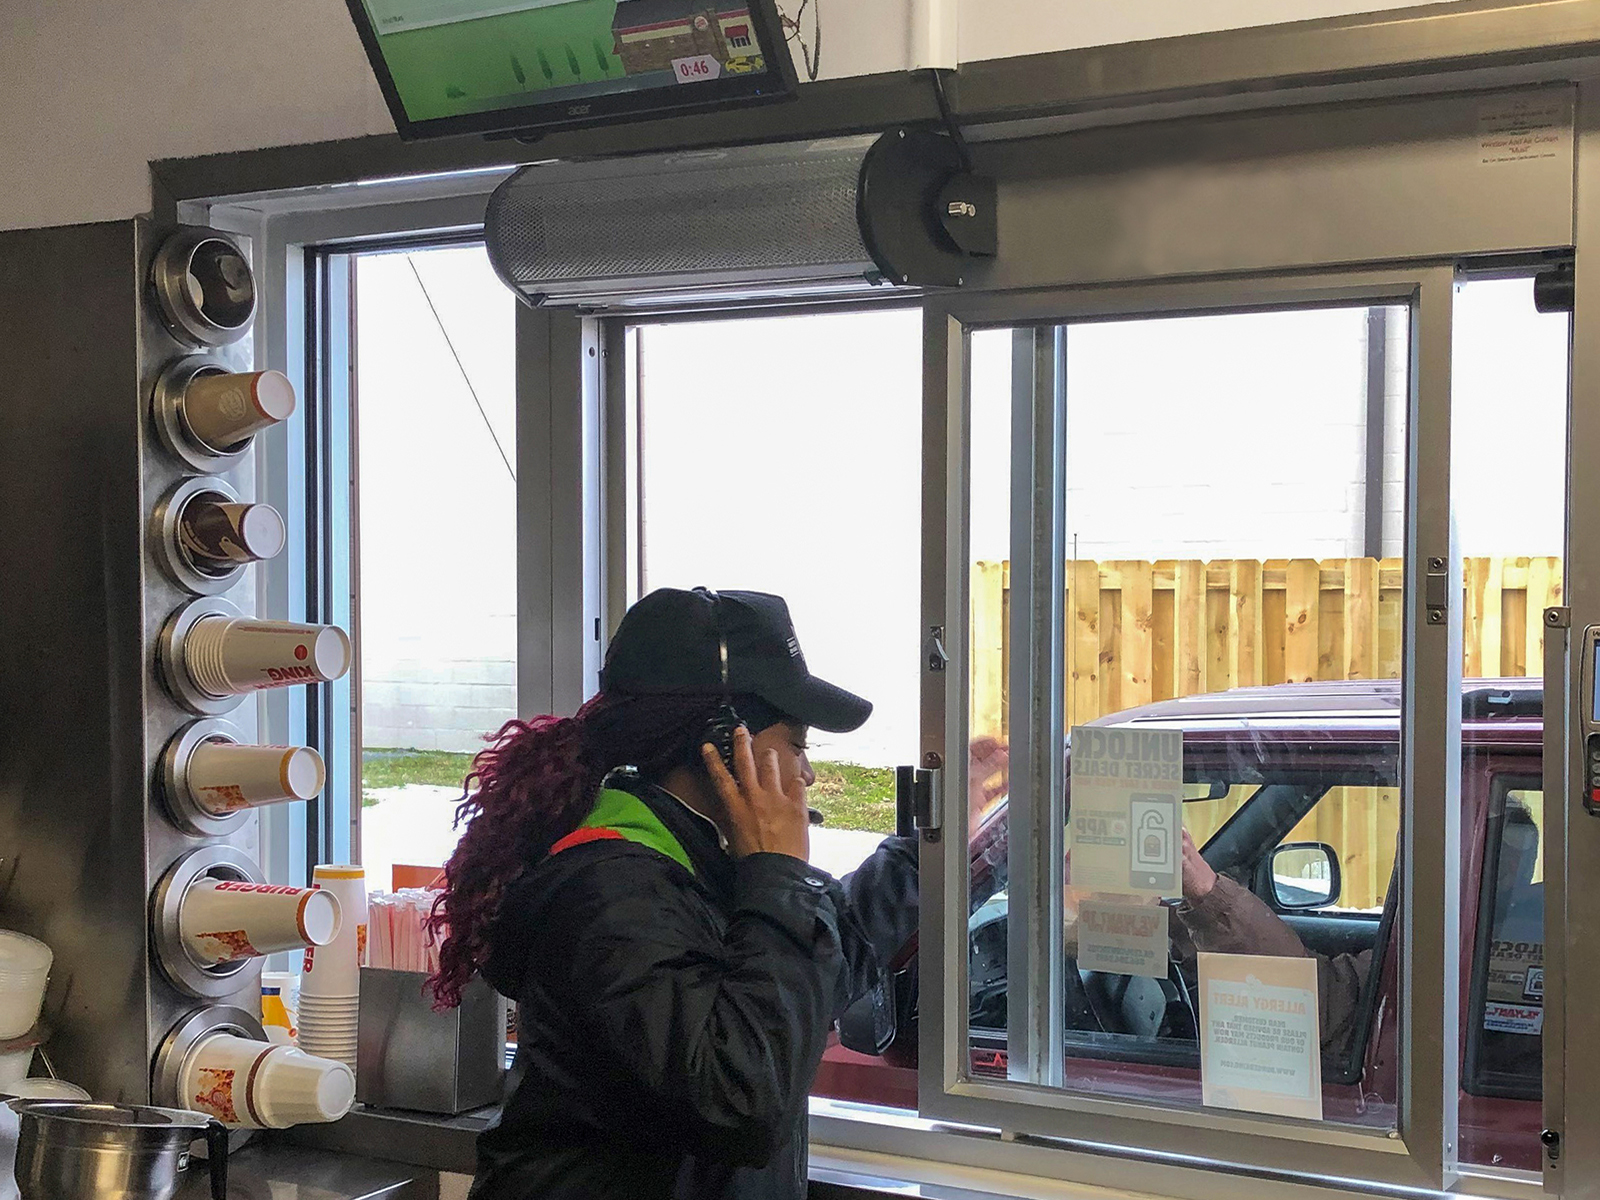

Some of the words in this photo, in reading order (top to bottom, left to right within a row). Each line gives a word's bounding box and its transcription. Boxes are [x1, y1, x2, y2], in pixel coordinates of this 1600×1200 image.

[680, 61, 709, 77] 0:46
[568, 105, 592, 116] acer
[267, 665, 315, 681] KING
